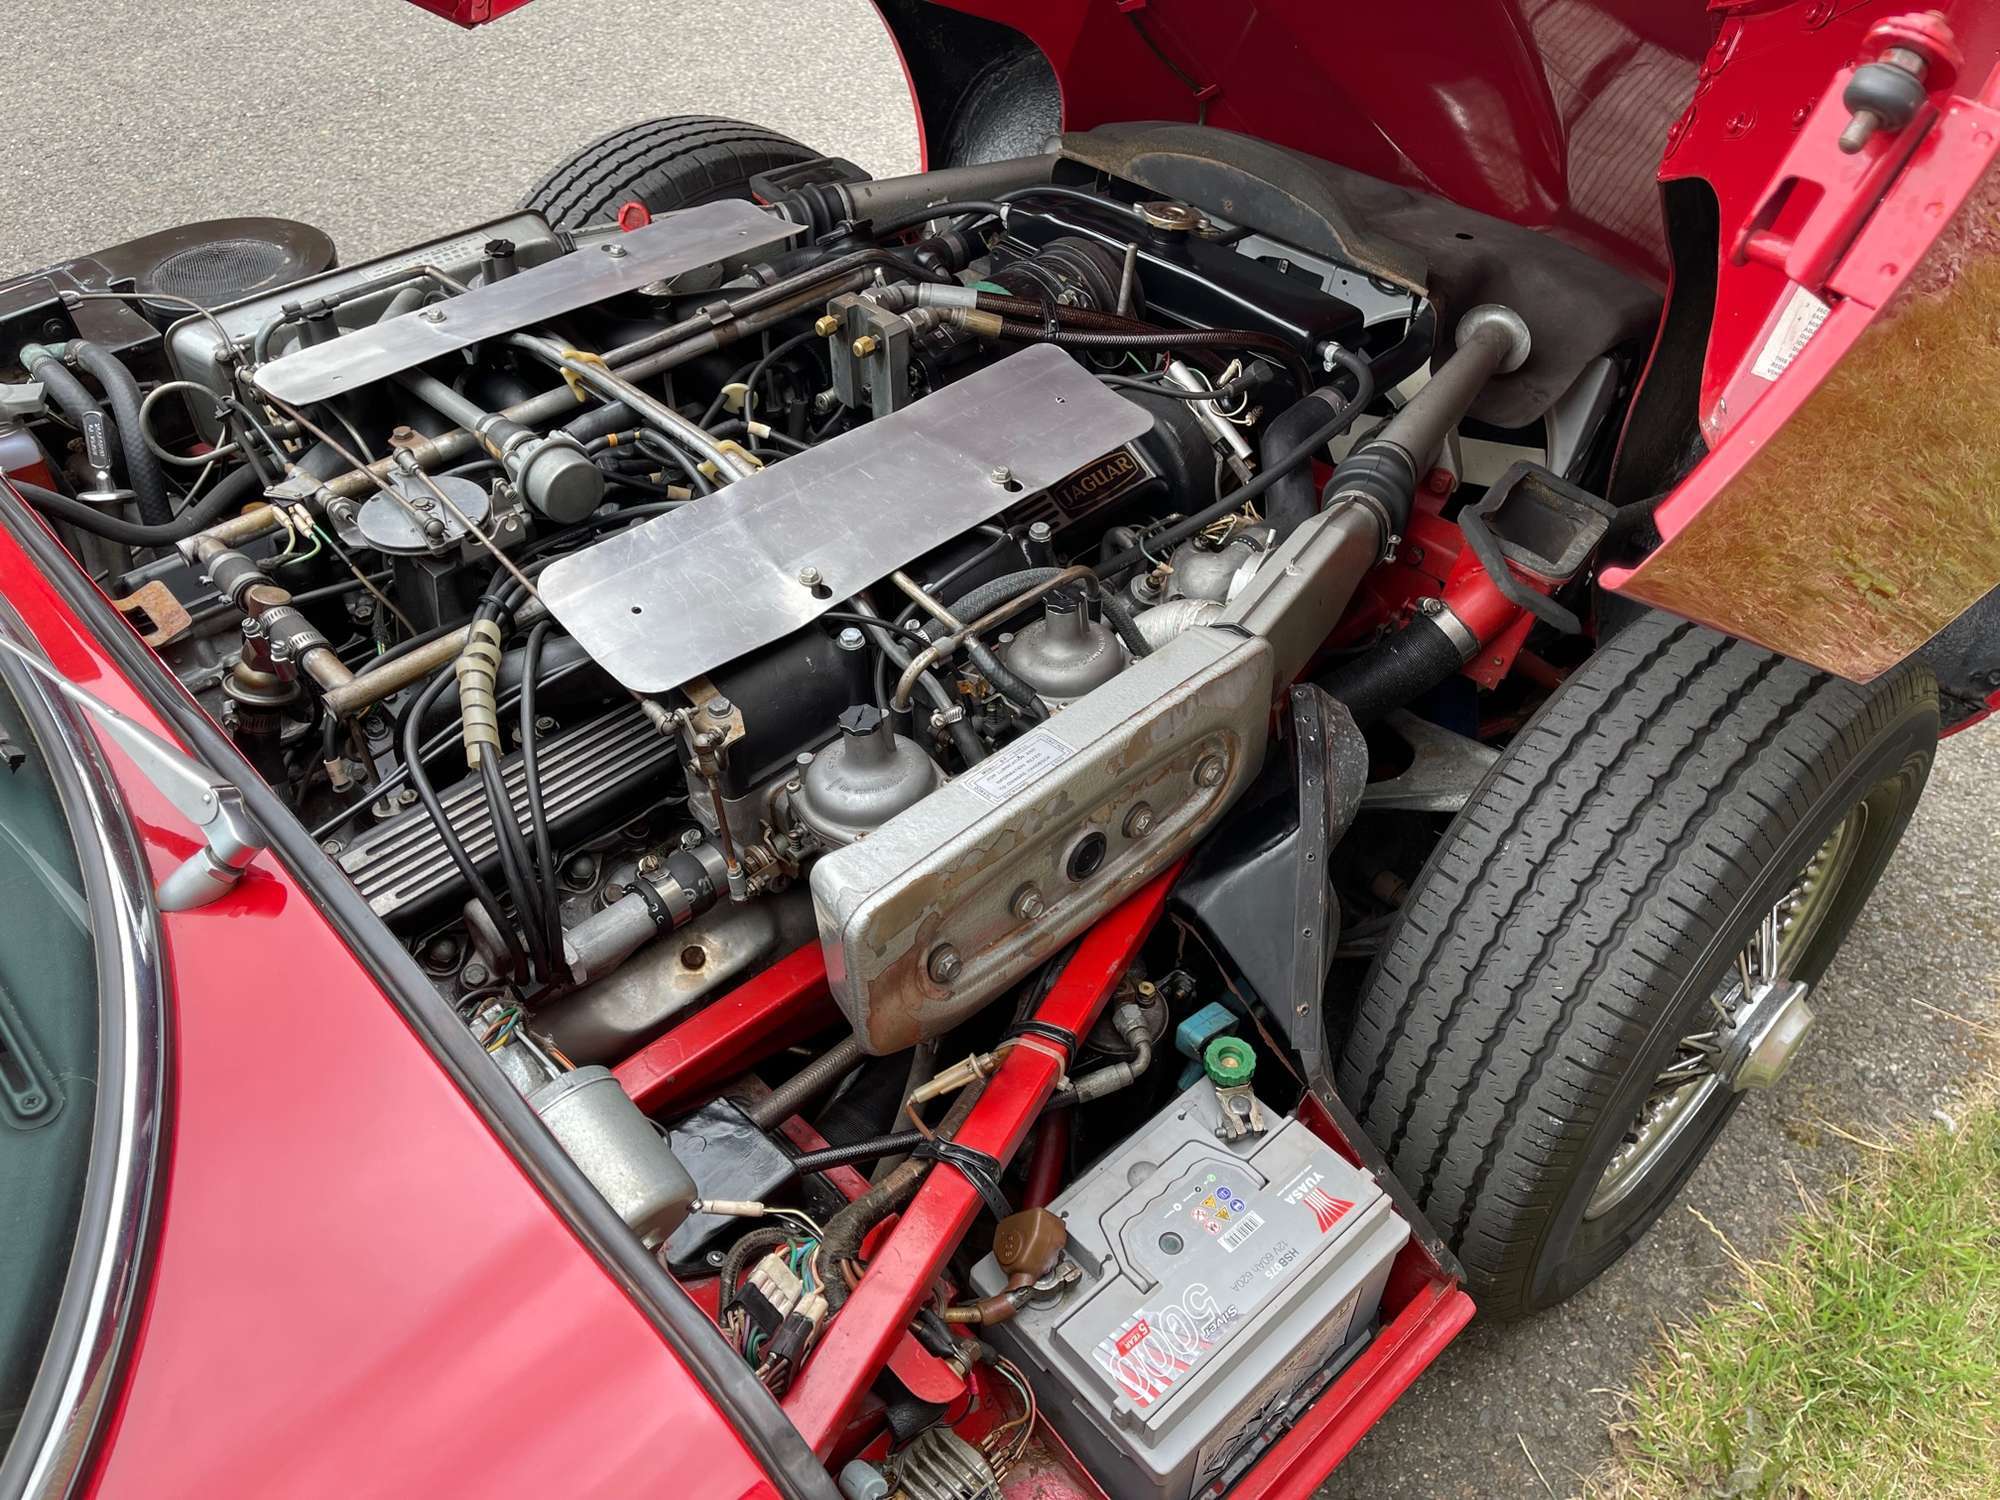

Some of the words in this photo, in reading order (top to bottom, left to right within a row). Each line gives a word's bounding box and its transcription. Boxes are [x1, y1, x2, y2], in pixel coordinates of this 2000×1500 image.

[1062, 456, 1133, 506] JAGUAR
[1283, 1171, 1325, 1206] YUASA
[1273, 1240, 1289, 1256] 12V
[1254, 1253, 1275, 1273] 60Ah
[1264, 1247, 1300, 1280] HSB075
[1230, 1271, 1254, 1292] 620A
[1138, 1321, 1149, 1336] 5
[1202, 1304, 1239, 1338] Silver
[1110, 1283, 1221, 1400] 5000
[1123, 1333, 1140, 1350] YEAR
